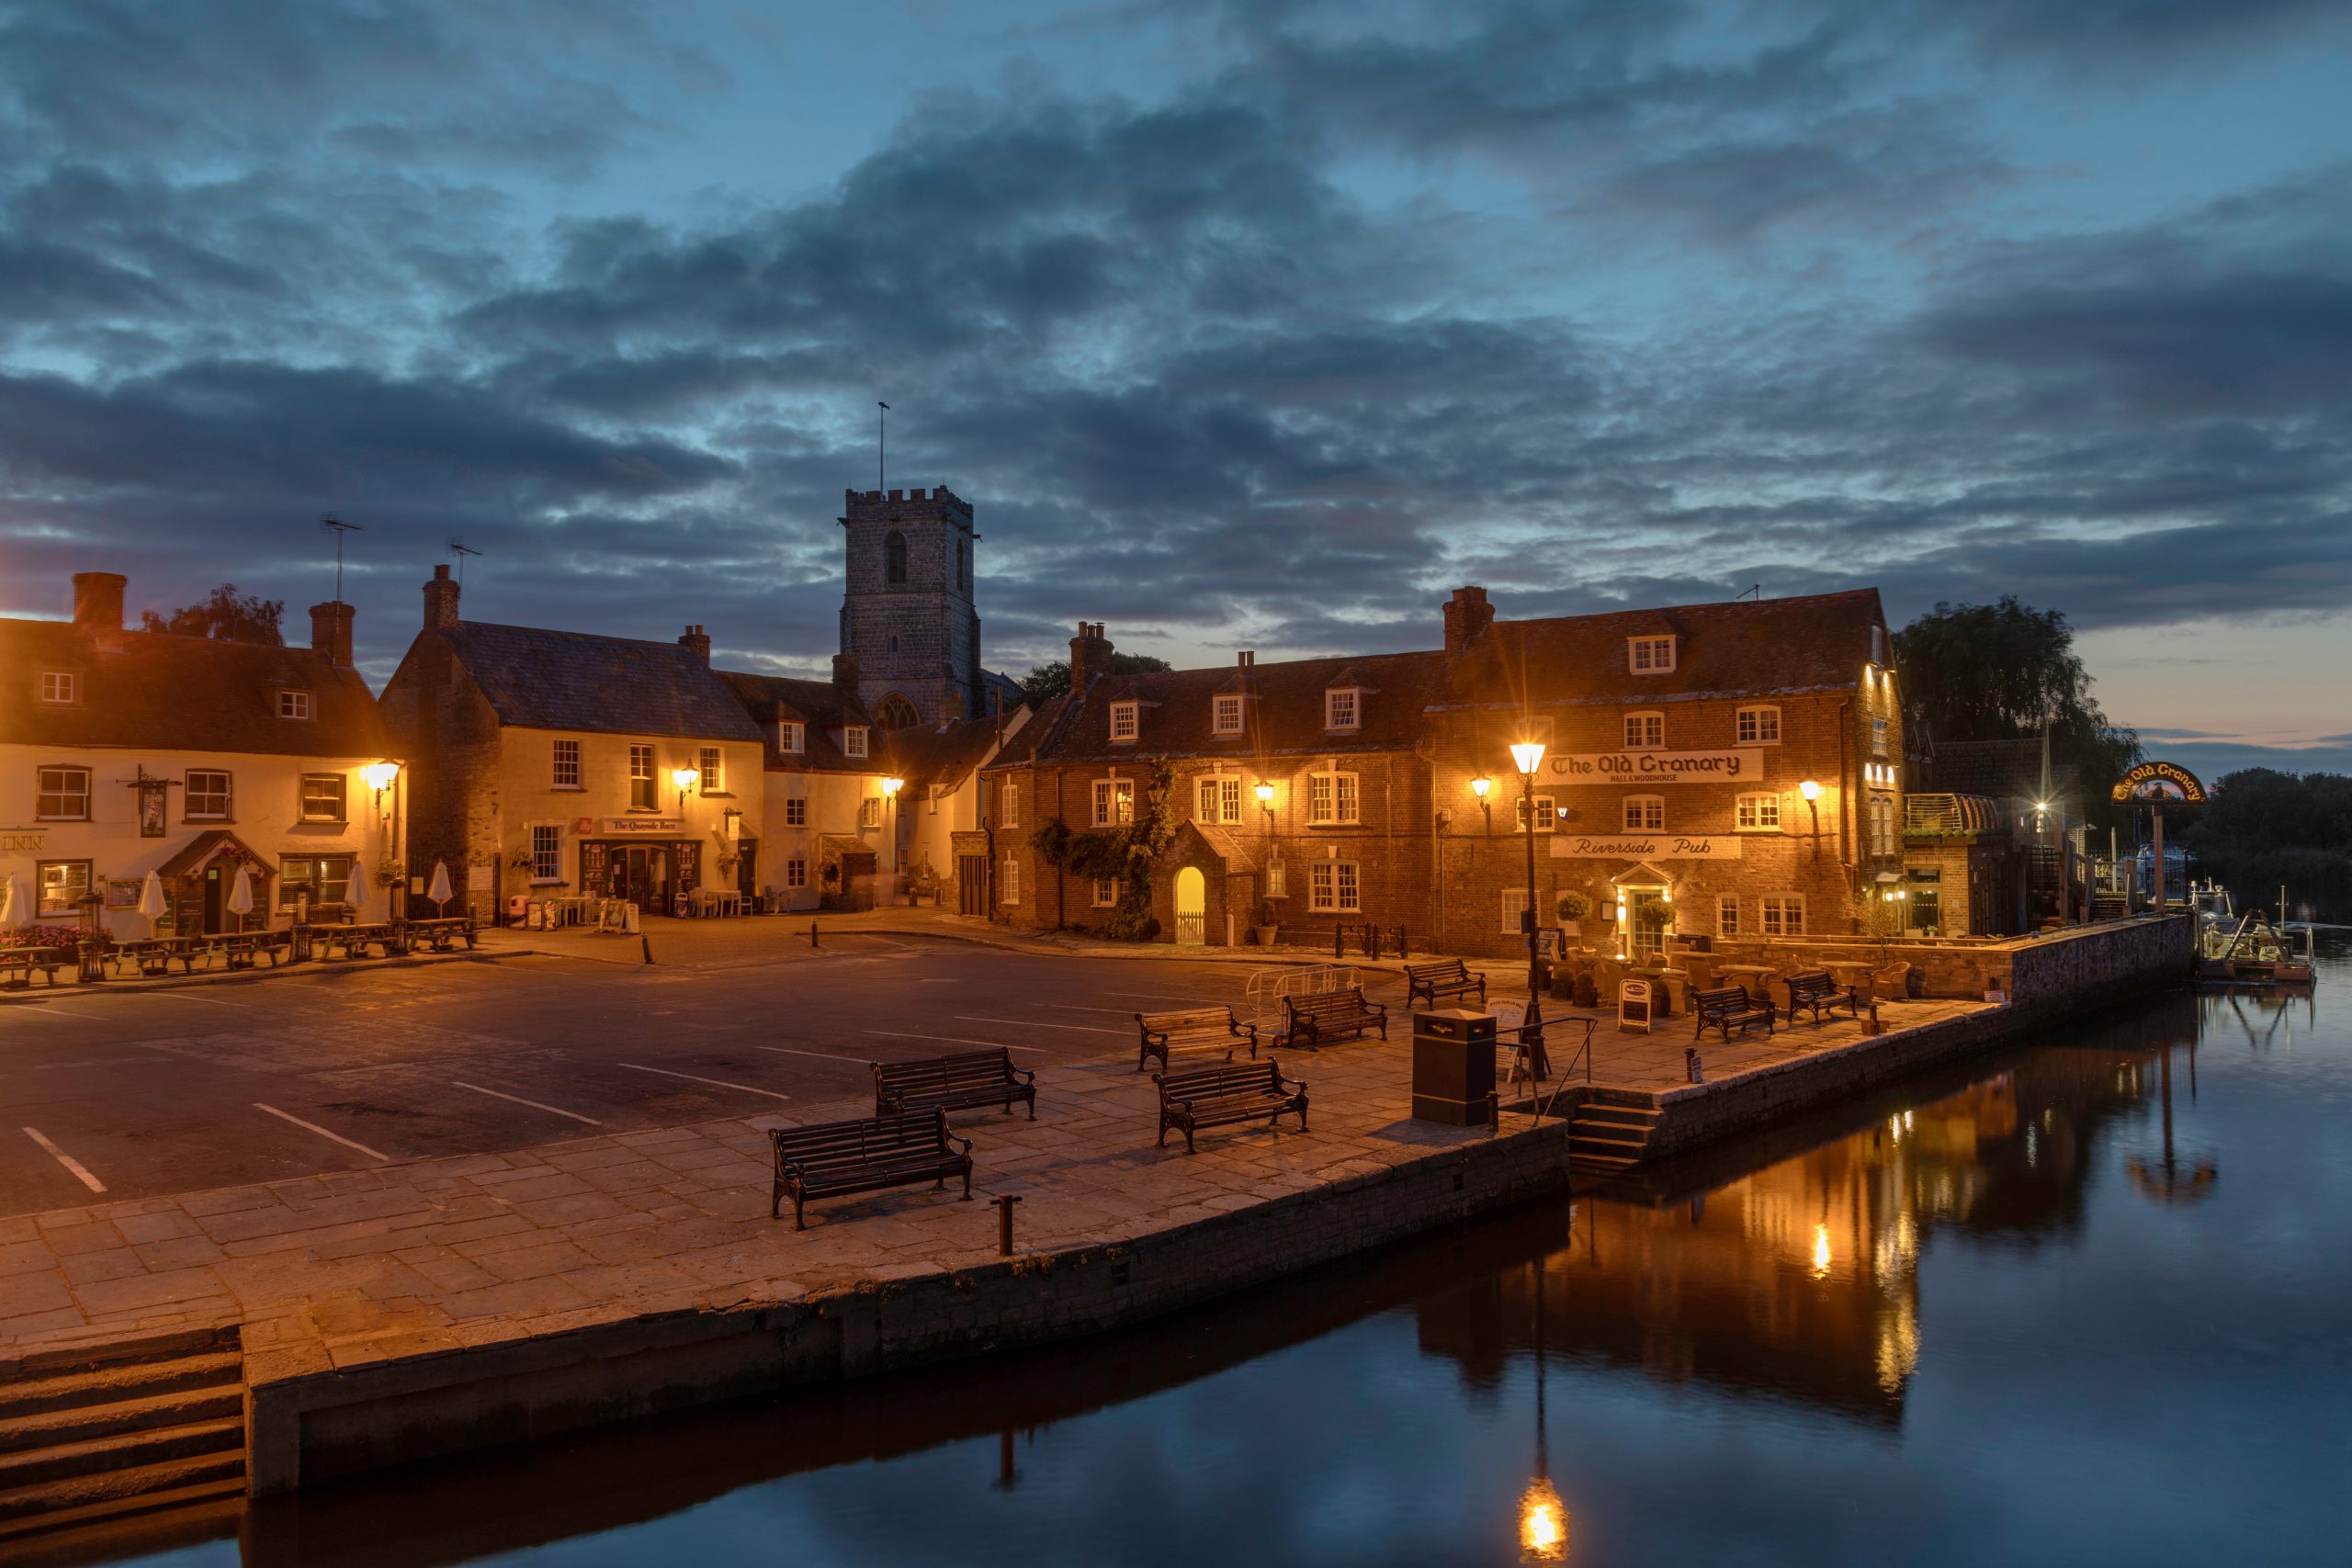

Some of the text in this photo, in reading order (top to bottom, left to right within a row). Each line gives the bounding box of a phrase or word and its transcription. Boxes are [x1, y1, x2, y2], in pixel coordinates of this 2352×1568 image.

[1551, 755, 1740, 776] The Old Granary
[1611, 774, 1628, 783] HALL
[1634, 773, 1678, 782] WOODHOUSE
[2114, 763, 2201, 801] The Old Granary
[615, 821, 628, 829] The
[628, 821, 659, 831] Quayside
[3, 836, 44, 851] INN
[1572, 838, 1711, 854] Riverside Pub
